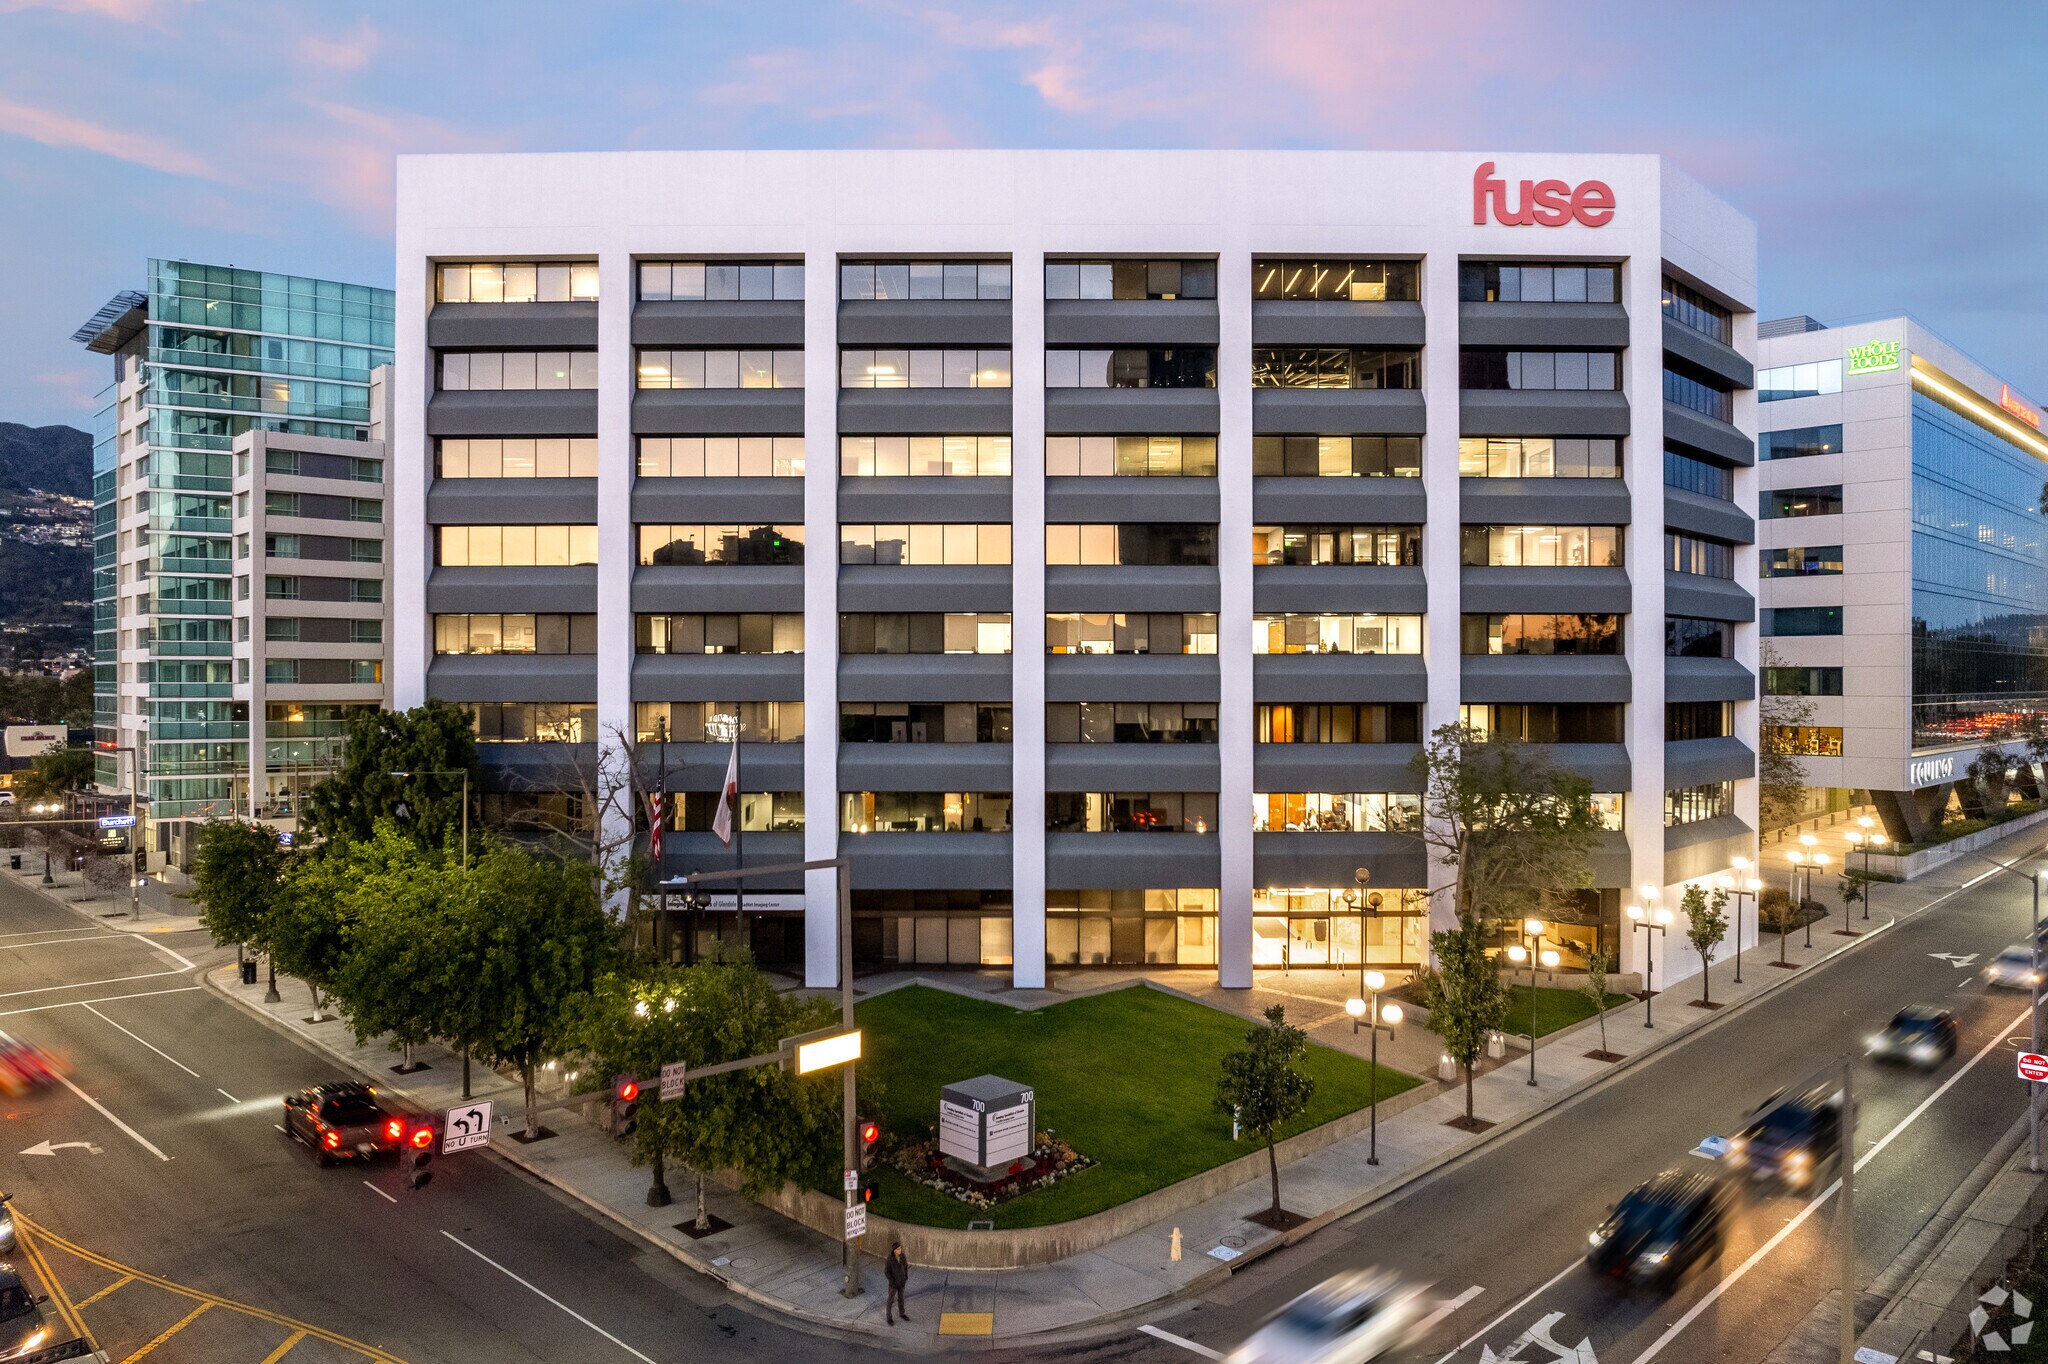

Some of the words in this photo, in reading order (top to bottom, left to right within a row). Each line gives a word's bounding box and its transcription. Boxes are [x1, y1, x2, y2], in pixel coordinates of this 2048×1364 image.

[1474, 161, 1616, 228] fuse
[1847, 340, 1900, 359] WHOLE
[1850, 353, 1898, 370] FOODS
[102, 817, 133, 826] Burchett
[662, 1069, 671, 1078] DO
[673, 1066, 684, 1077] NOT
[662, 1078, 684, 1089] BLOCK
[1020, 1090, 1034, 1104] 700
[971, 1099, 985, 1113] 700
[458, 1137, 467, 1147] U
[470, 1135, 488, 1144] TURN
[846, 1211, 855, 1220] DO
[855, 1207, 865, 1217] NOT
[846, 1218, 865, 1230] BLOCK
